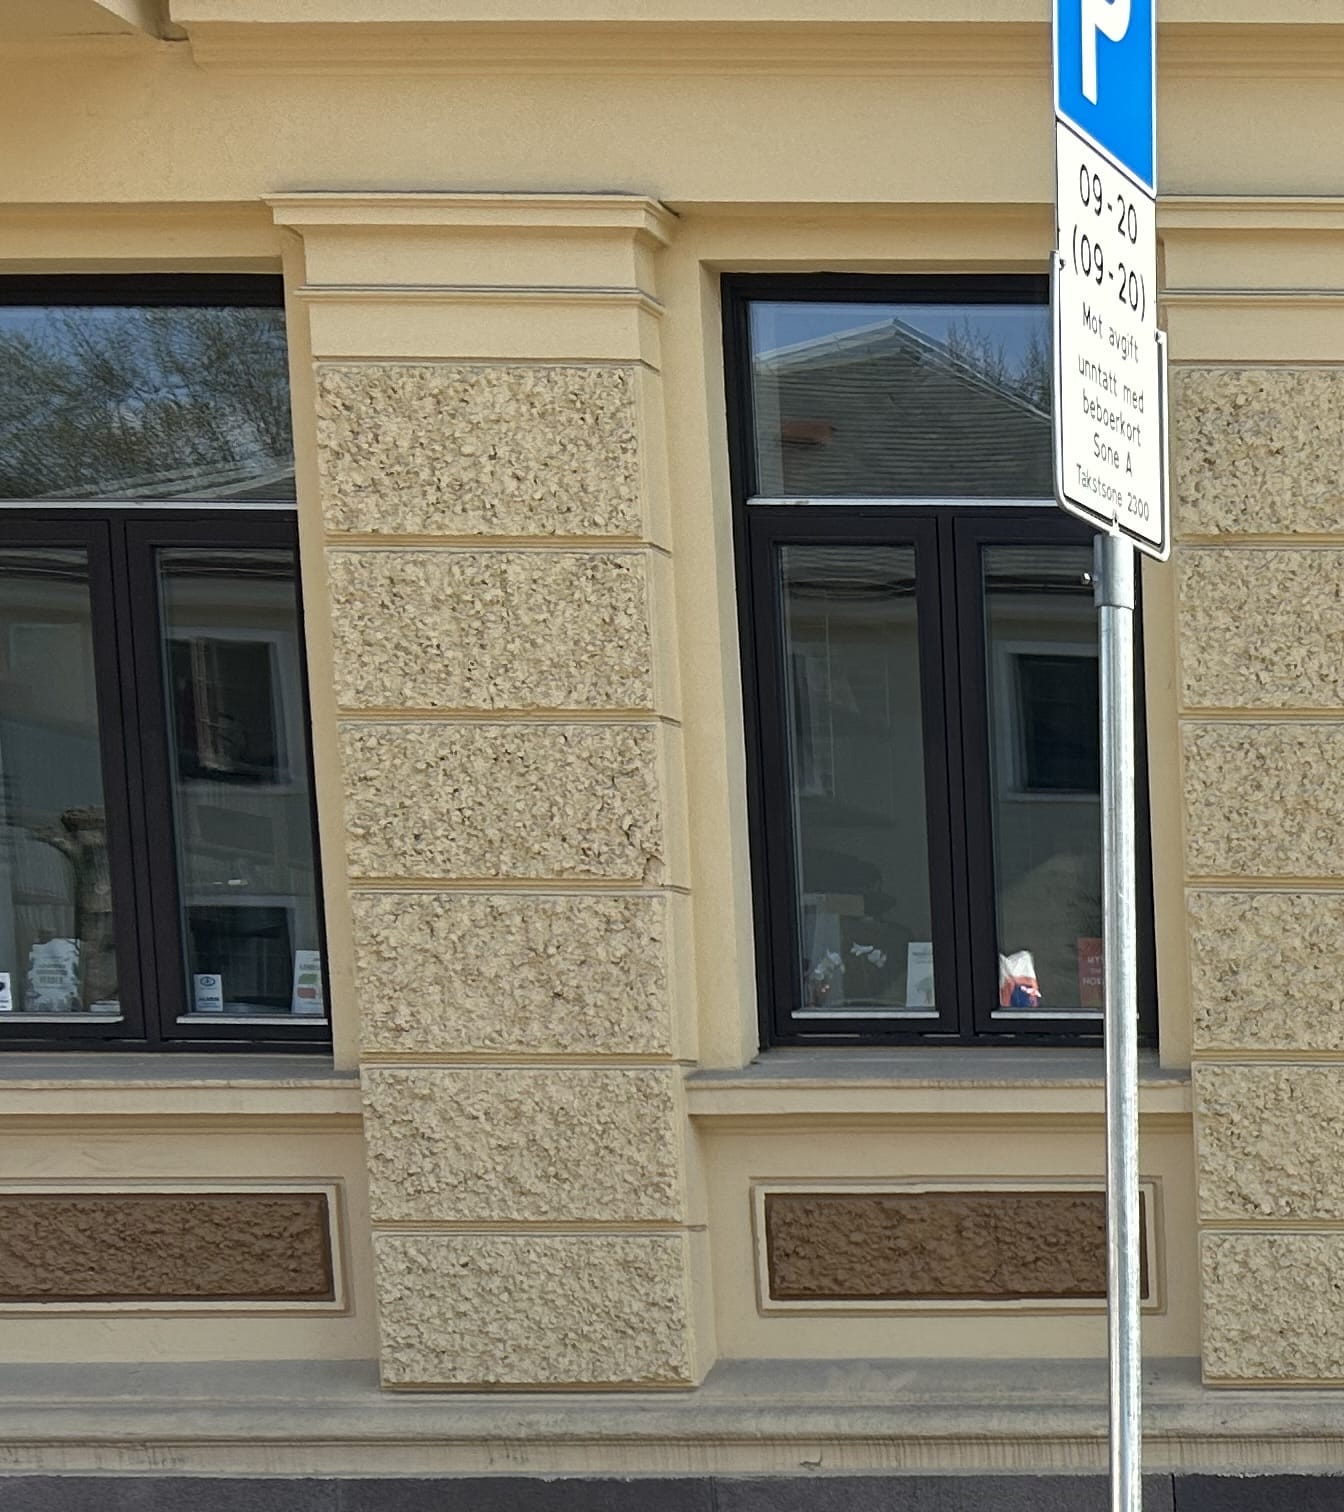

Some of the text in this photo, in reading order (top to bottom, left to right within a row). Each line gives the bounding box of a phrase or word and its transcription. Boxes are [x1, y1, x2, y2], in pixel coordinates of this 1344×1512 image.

[1079, 163, 1138, 245] 09-20
[1073, 223, 1145, 323] (09-20)
[1082, 301, 1139, 364] Mot avgift
[1078, 354, 1144, 414] unntatt med
[1082, 387, 1142, 448] beboerkort
[1093, 431, 1133, 479] Sone A
[1076, 462, 1150, 522] Takstsone 2300
